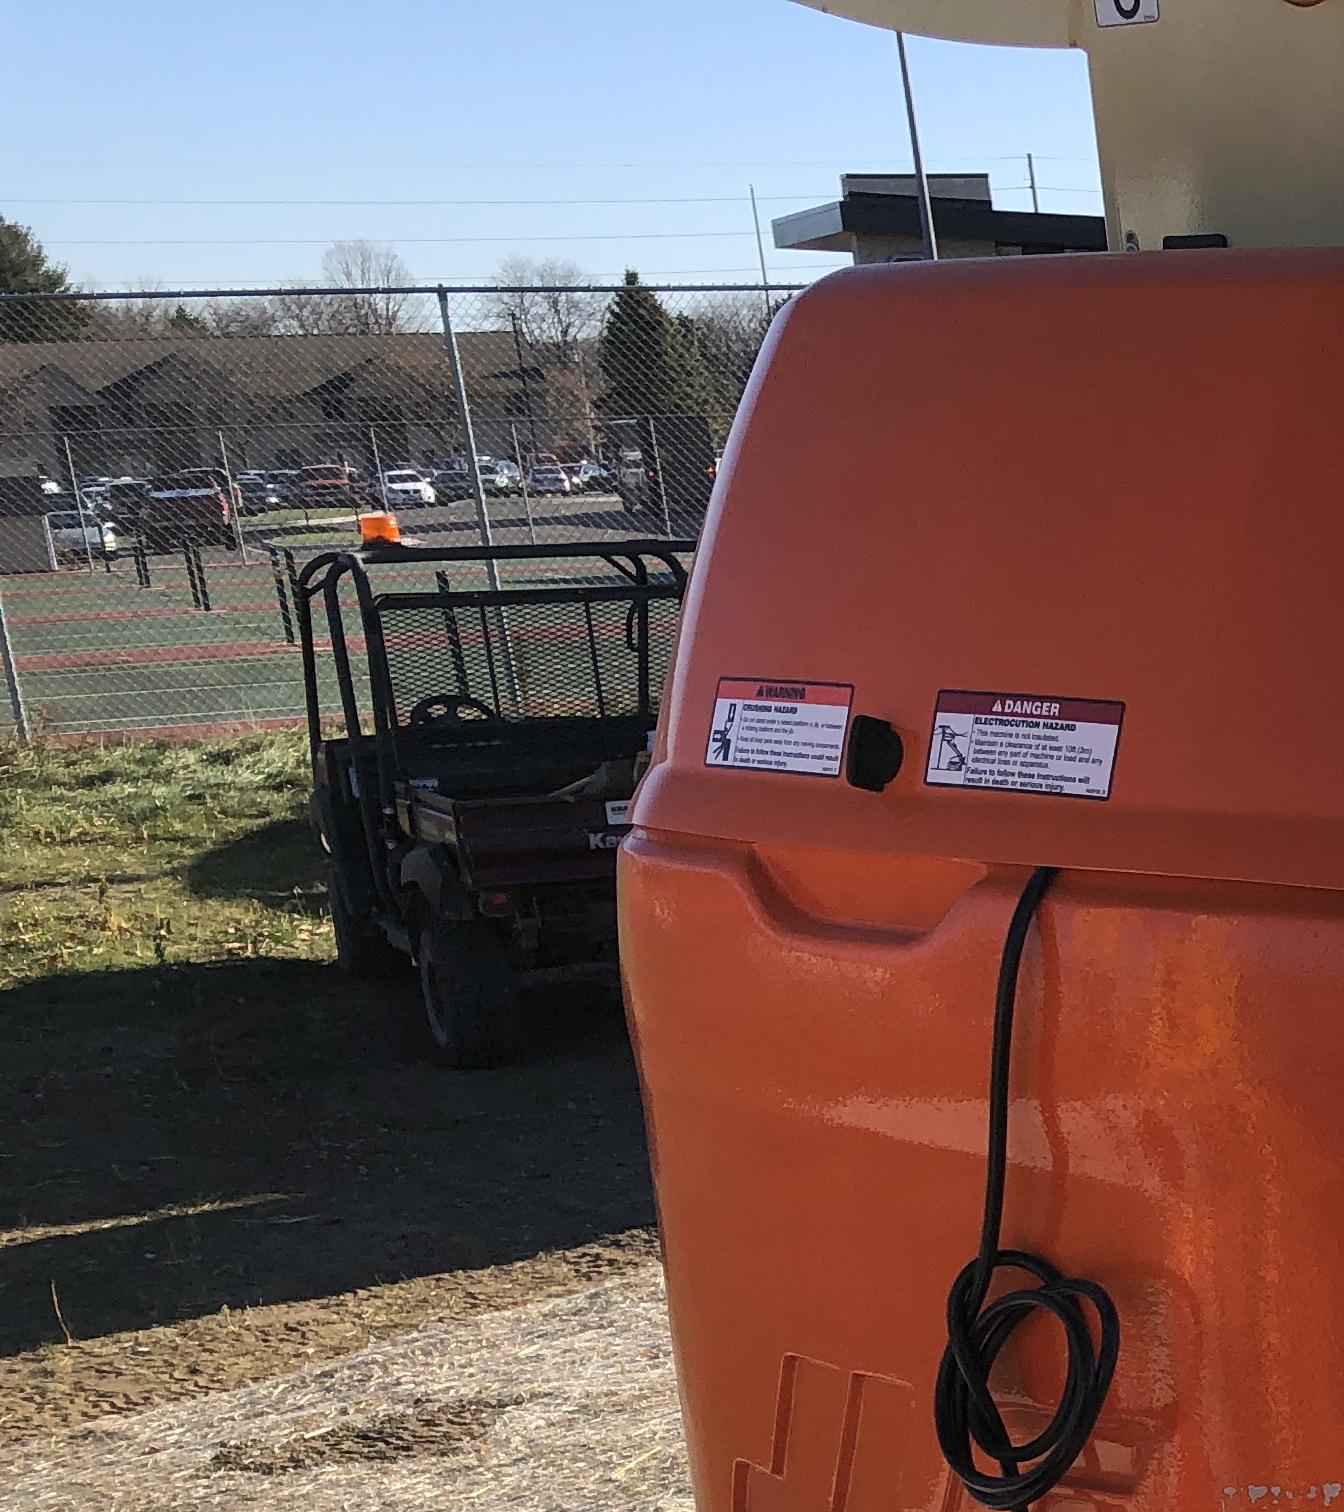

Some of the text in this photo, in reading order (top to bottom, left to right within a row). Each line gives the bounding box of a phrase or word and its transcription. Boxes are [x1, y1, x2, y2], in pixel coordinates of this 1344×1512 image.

[1004, 700, 1060, 716] DANGER
[975, 717, 1076, 731] ELECTROCUTION HAZARD
